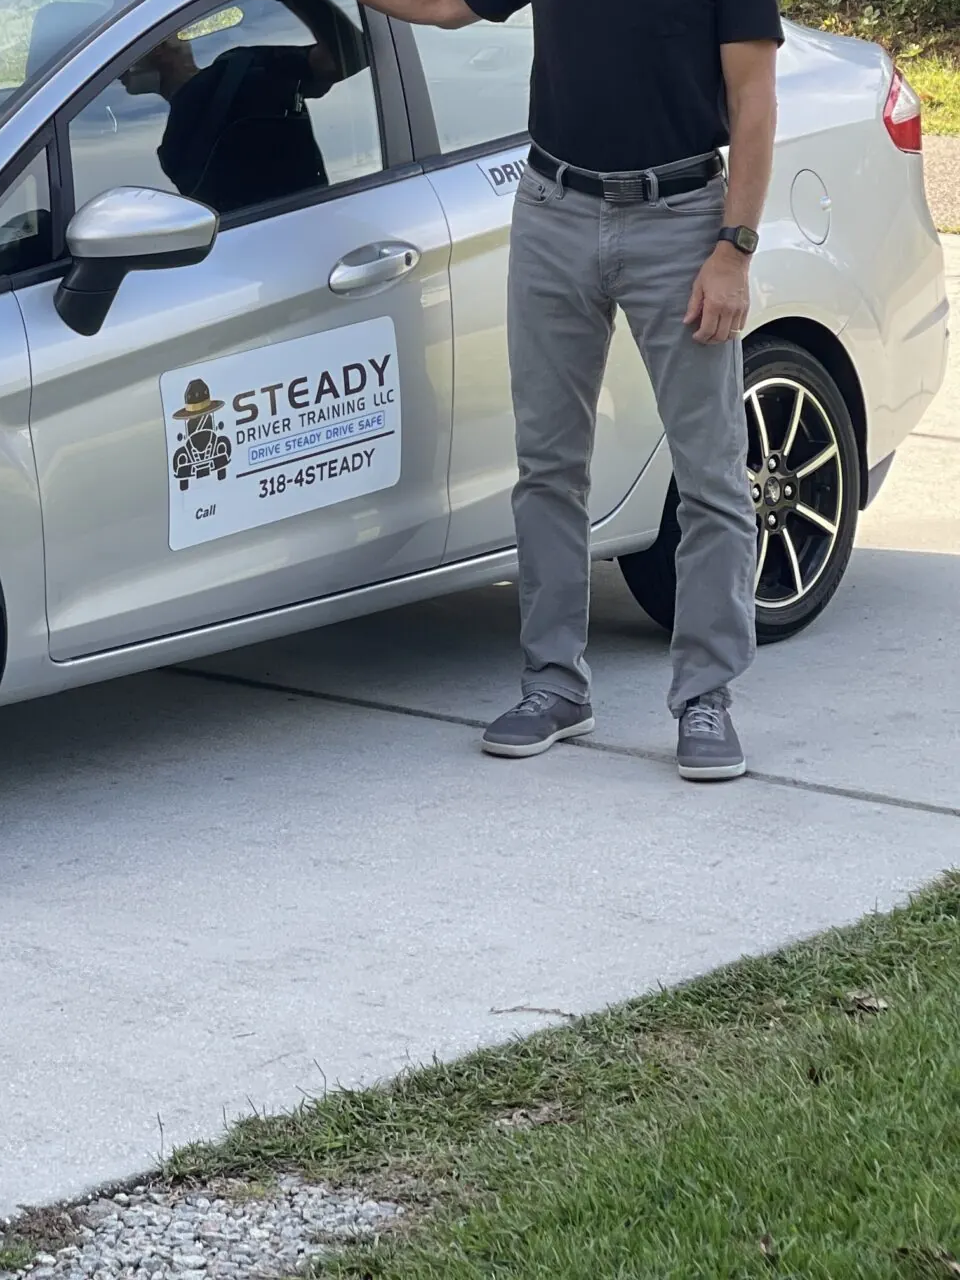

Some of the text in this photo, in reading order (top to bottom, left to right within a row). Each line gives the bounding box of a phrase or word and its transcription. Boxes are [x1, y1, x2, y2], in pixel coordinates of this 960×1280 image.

[232, 354, 391, 426] STEADY
[236, 389, 395, 445] DRIVER TRAINING LLC
[251, 414, 383, 461] DRIVE STEADY DRIVE SAFE
[259, 448, 375, 499] 318-4STEADY
[195, 504, 216, 520] Call
